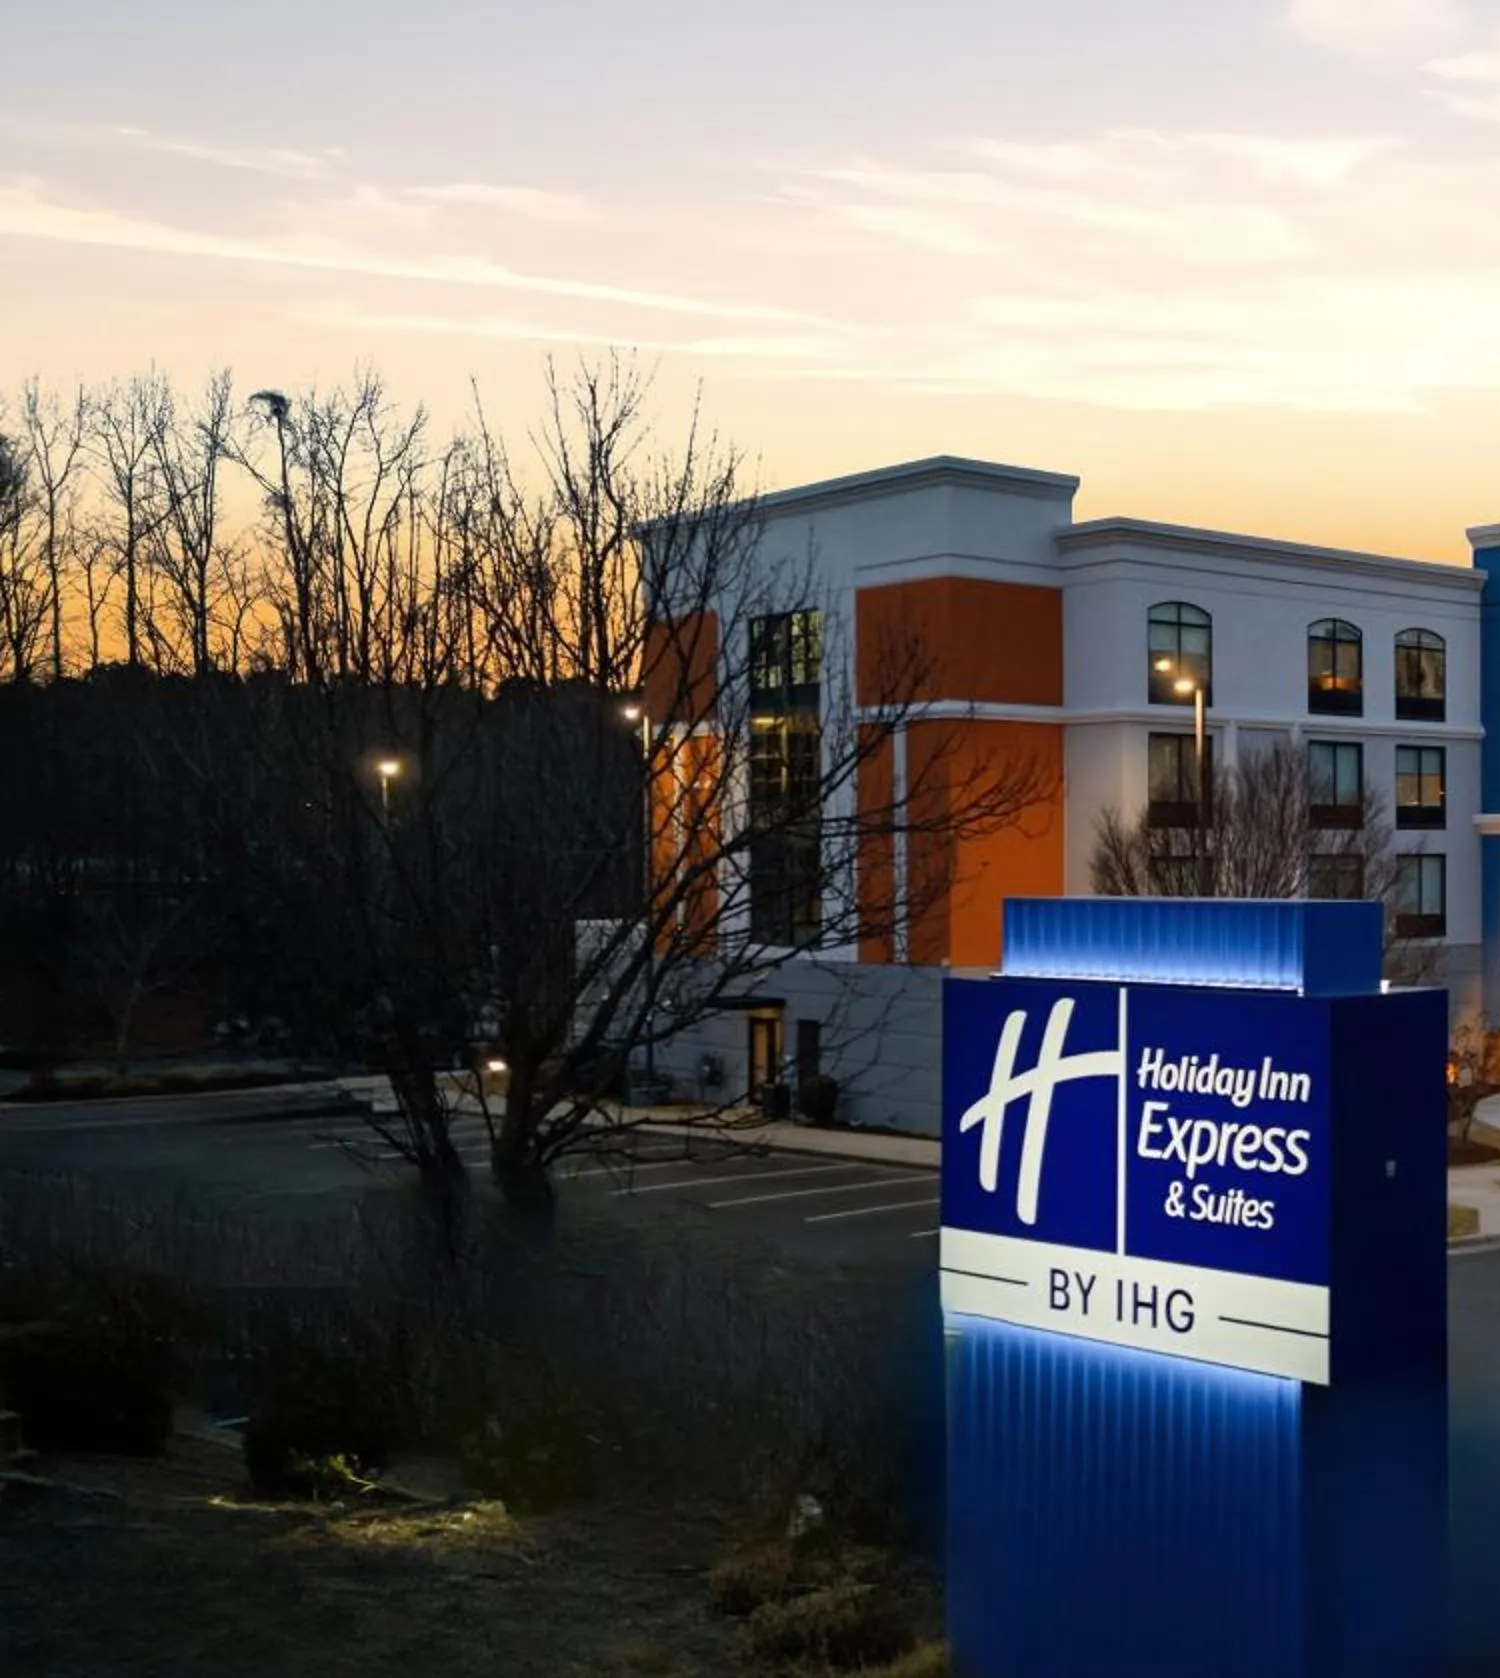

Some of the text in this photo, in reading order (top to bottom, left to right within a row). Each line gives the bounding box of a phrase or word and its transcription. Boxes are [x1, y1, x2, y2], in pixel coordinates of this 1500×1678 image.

[1137, 1047, 1311, 1107] Holiday Inn
[1137, 1101, 1311, 1178] Express
[1164, 1182, 1275, 1230] & Suites
[1049, 1268, 1195, 1333] BY IHG
